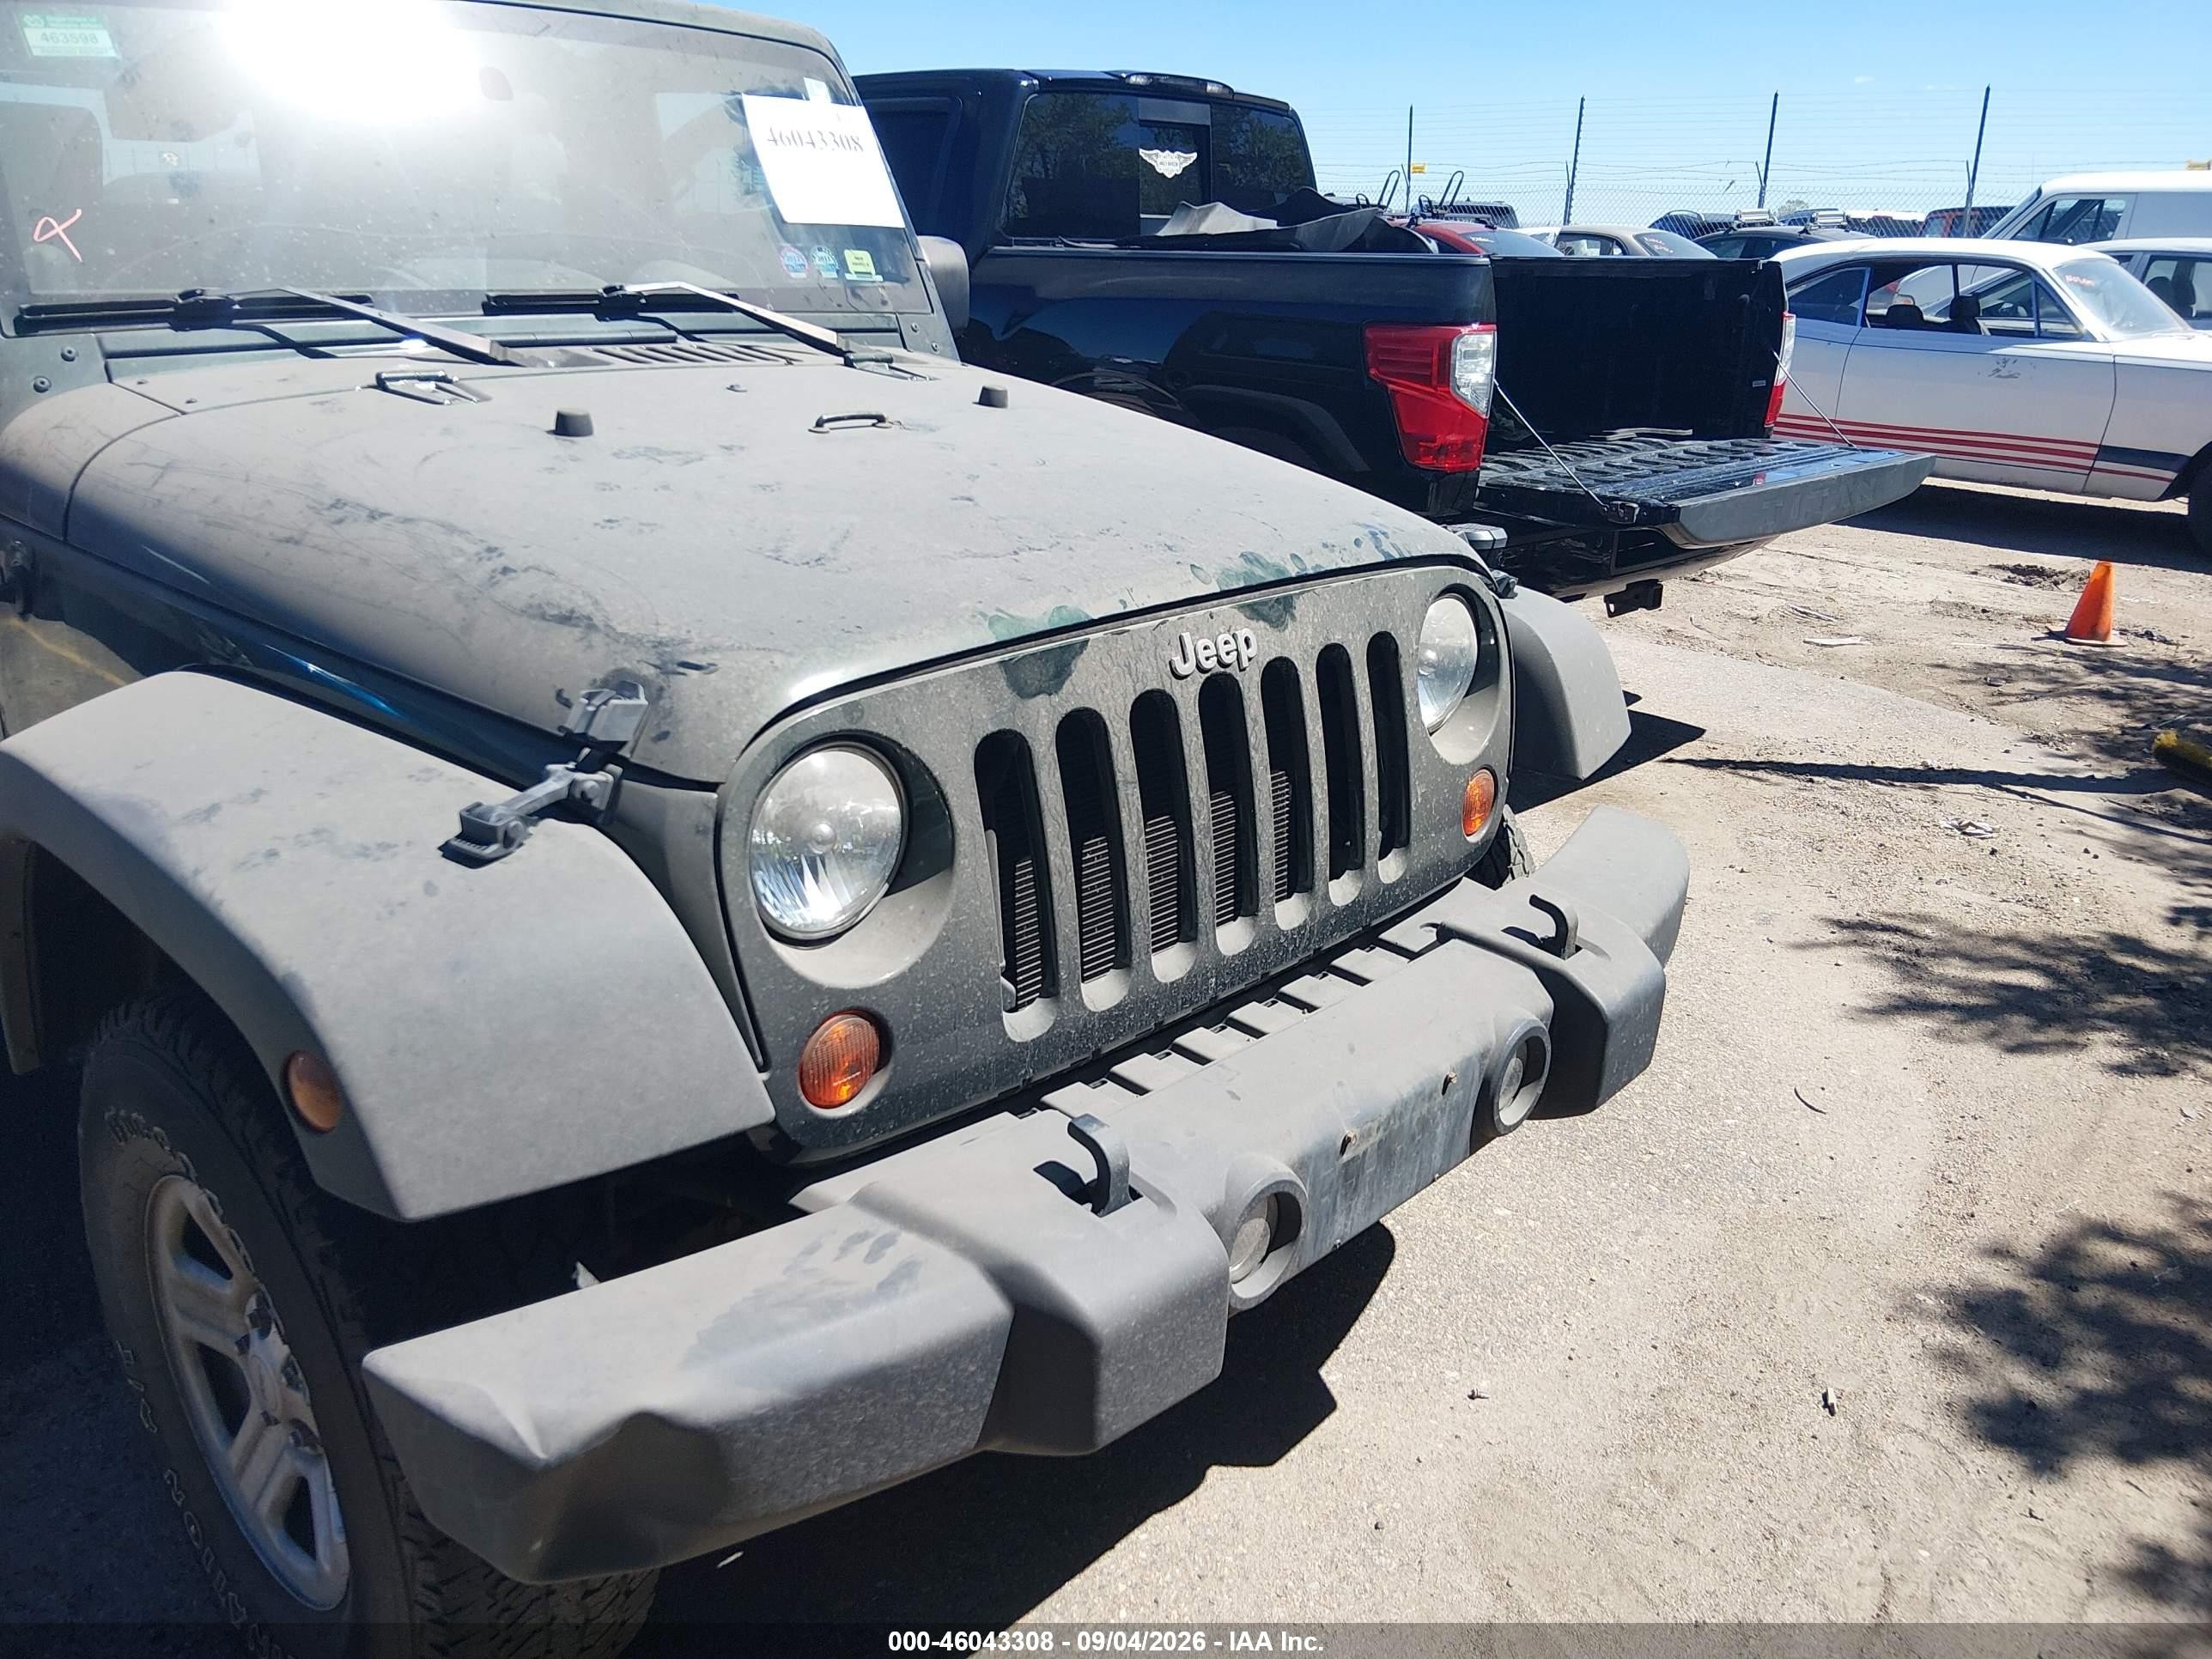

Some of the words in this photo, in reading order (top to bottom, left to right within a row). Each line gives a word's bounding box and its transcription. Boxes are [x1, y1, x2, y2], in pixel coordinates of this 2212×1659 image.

[767, 127, 864, 152] 46043308
[1761, 477, 1876, 525] TITAN
[1170, 628, 1257, 678] Jeep
